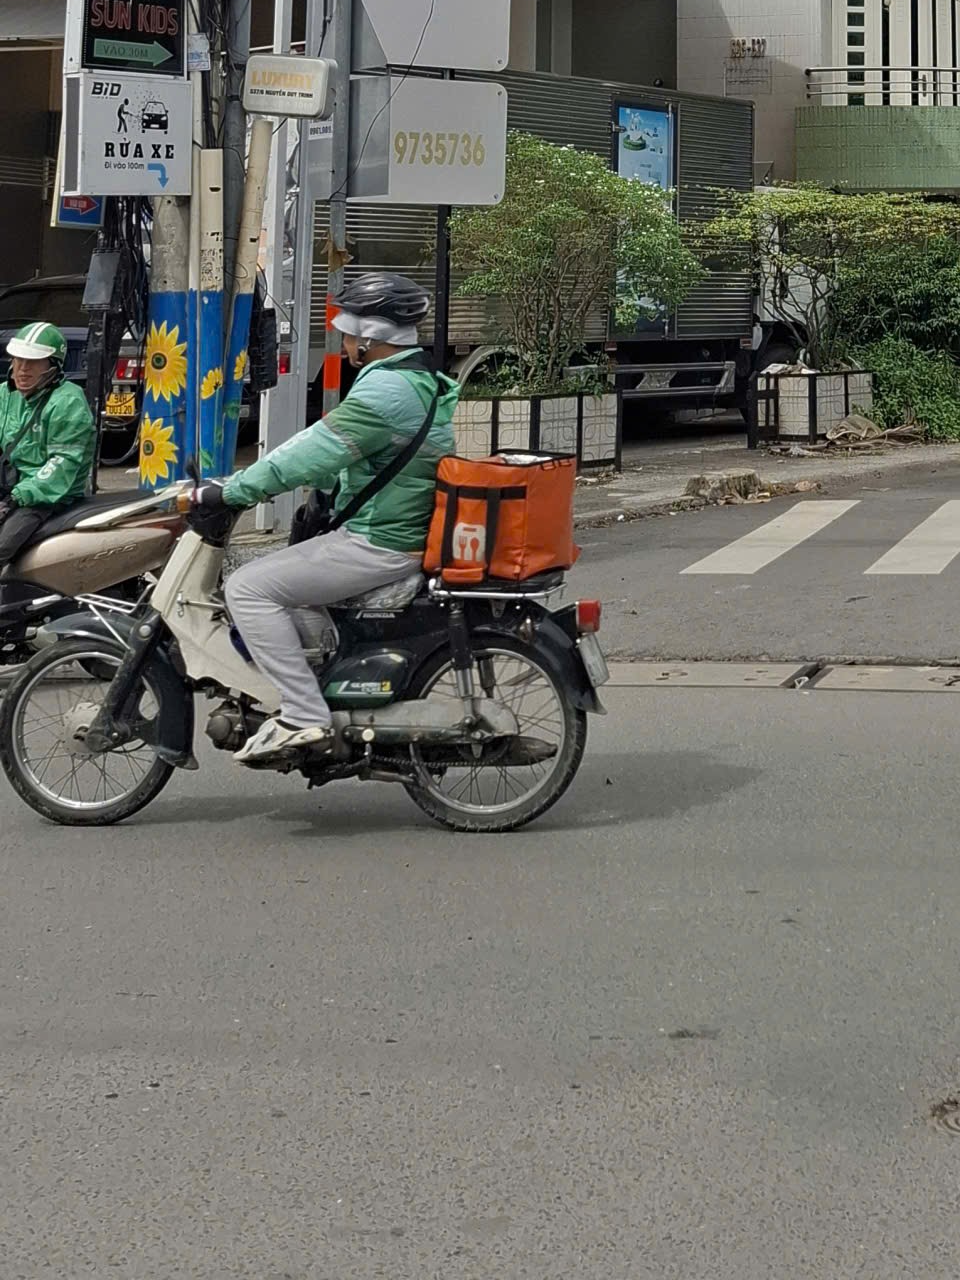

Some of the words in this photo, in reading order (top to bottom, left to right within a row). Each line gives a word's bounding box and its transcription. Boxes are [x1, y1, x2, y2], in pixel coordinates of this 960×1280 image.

[137, 3, 179, 37] KIDS
[129, 45, 149, 59] 30M
[251, 70, 315, 90] LUXURY
[104, 137, 144, 158] RỬA
[151, 144, 175, 160] XE
[394, 131, 486, 167] 9735736
[113, 161, 126, 170] vào
[127, 162, 145, 170] 100m
